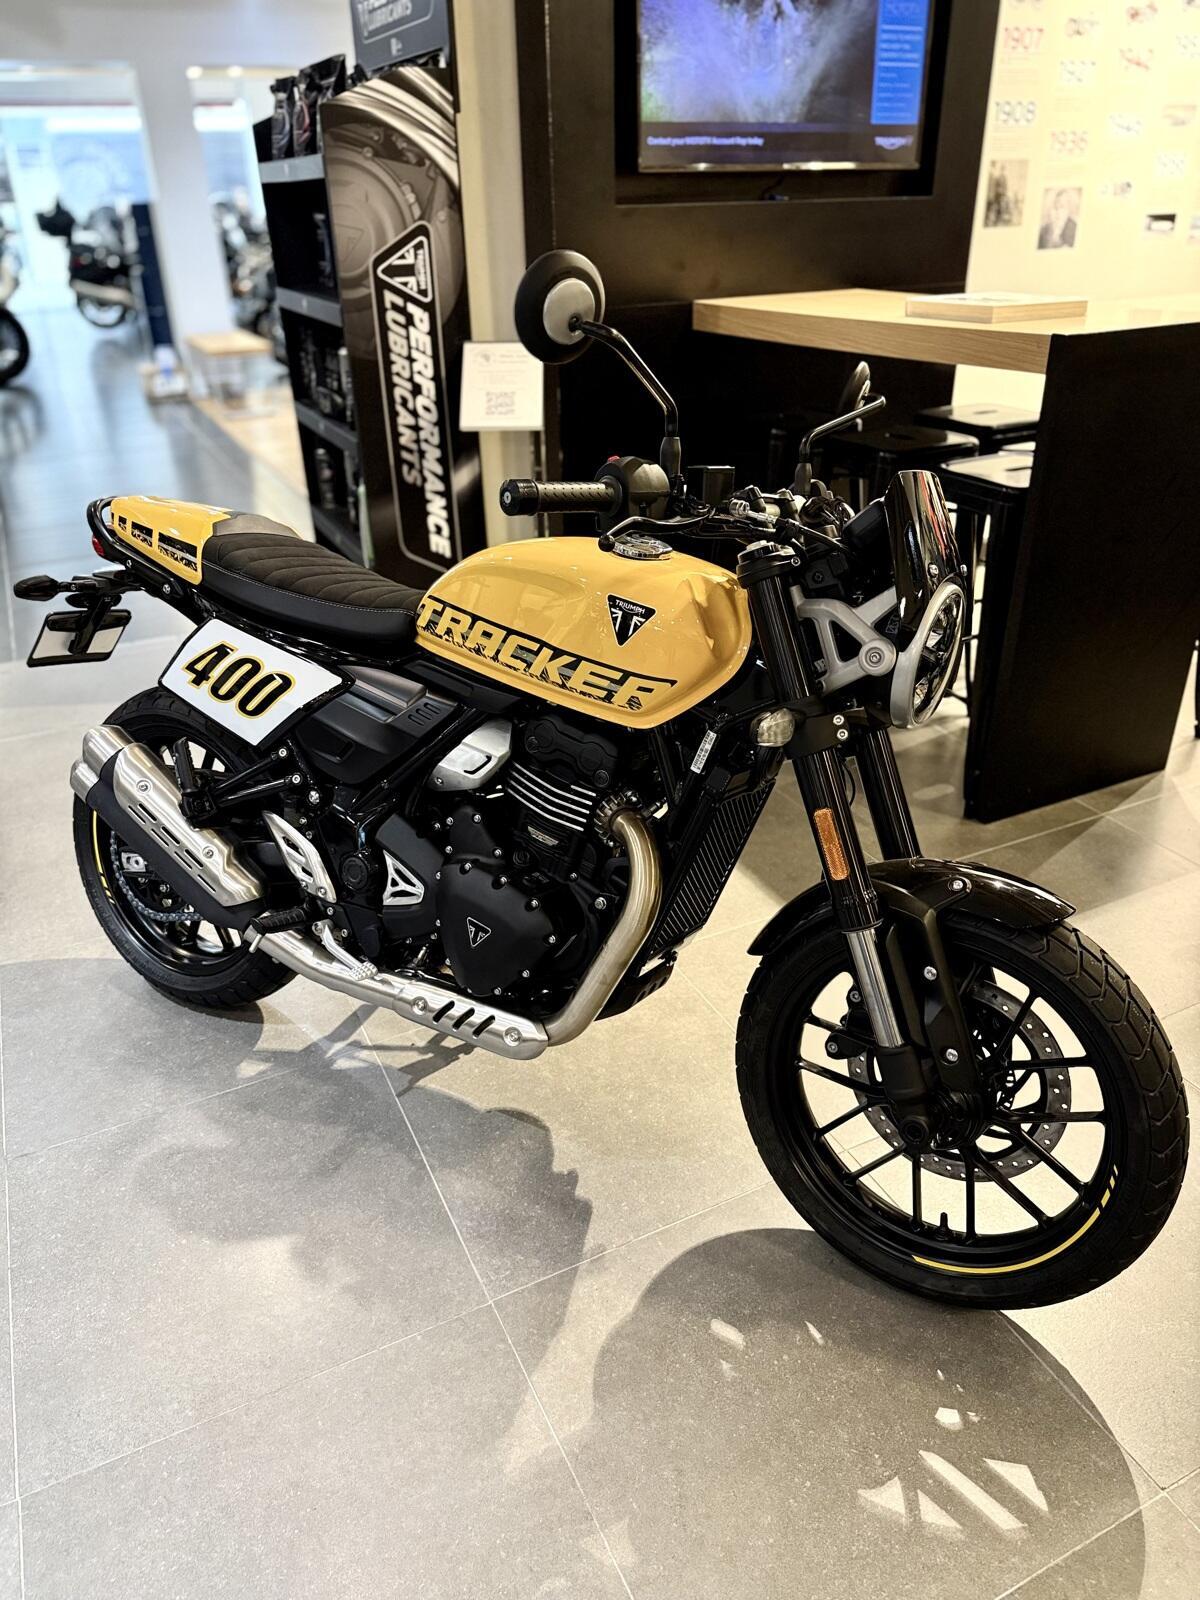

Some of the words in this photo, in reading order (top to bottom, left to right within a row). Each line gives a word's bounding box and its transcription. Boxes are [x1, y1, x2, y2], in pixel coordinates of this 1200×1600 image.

[1004, 27, 1044, 50] 1907
[995, 101, 1036, 123] 1908
[384, 289, 422, 488] LUBRICANTS
[407, 302, 451, 558] PERFORMANCE
[615, 599, 646, 615] TRIUMPH
[181, 641, 295, 718] 400
[416, 599, 675, 710] TRACKER
